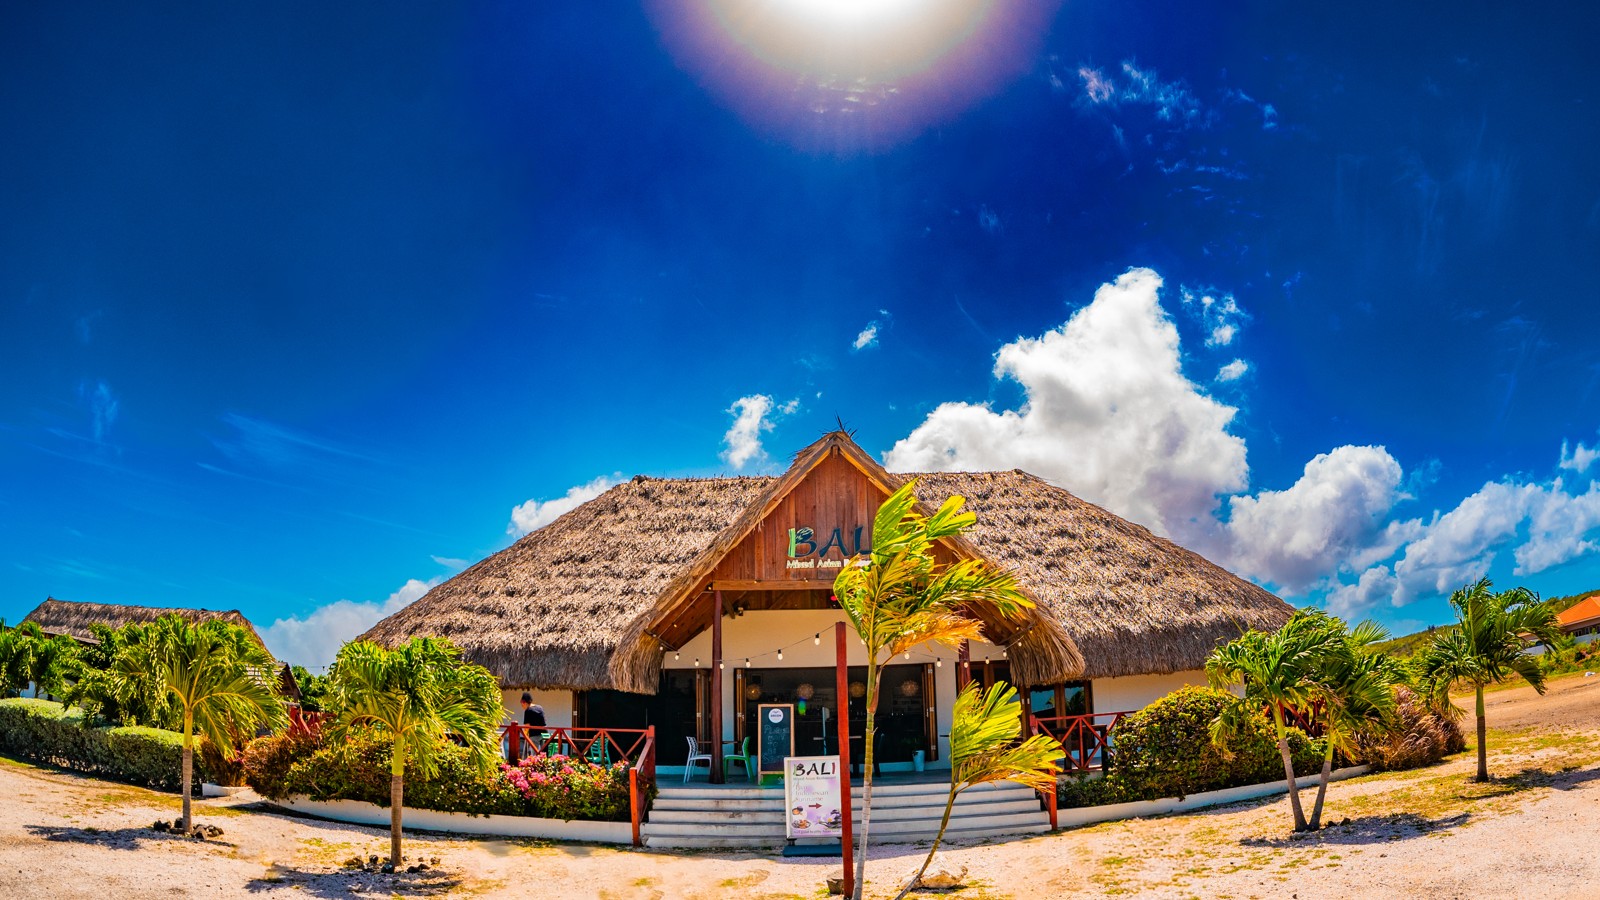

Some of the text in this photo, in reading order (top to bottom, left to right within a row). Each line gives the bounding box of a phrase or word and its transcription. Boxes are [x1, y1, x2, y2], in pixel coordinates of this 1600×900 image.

[788, 527, 873, 558] BAL
[786, 559, 815, 569] Mixed
[793, 762, 836, 776] BALI
